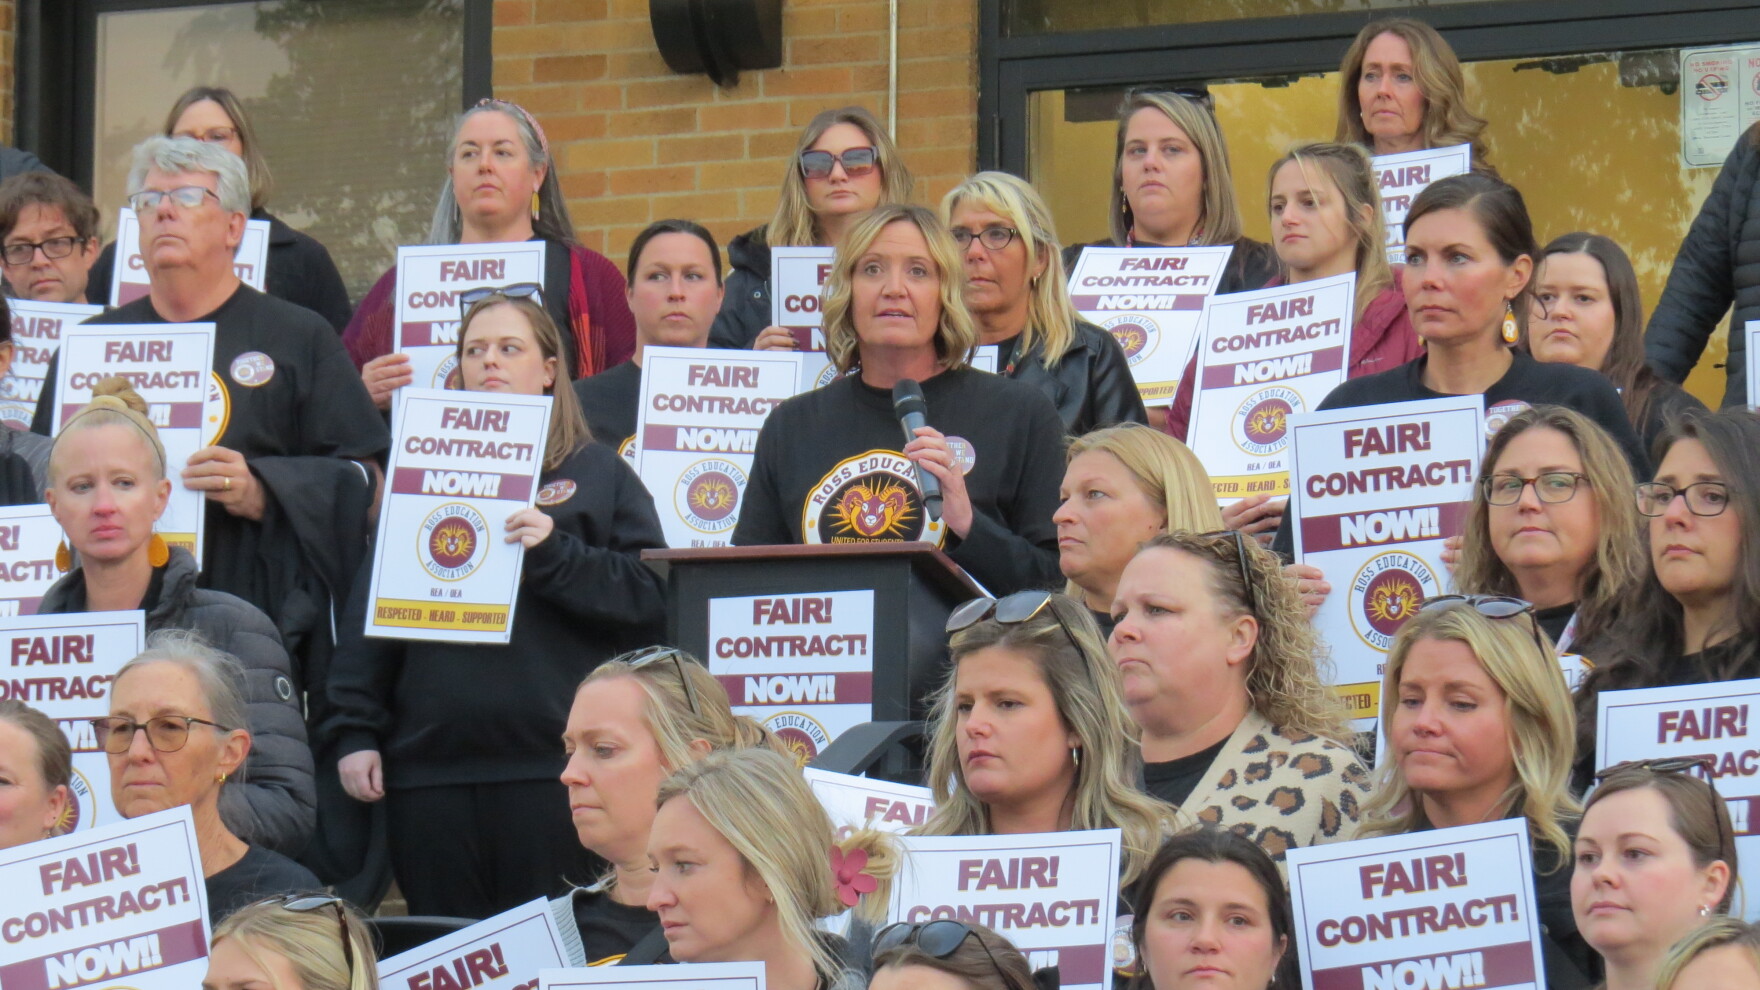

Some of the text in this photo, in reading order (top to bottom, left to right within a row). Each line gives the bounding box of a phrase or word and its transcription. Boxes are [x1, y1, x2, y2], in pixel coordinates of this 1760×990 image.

[440, 259, 505, 282] FAIR!
[1119, 257, 1188, 271] FAIR!
[1082, 275, 1210, 287] CONTRACT!
[1096, 295, 1176, 310] NOW!!
[1246, 296, 1314, 325] FAIR!
[12, 316, 62, 340] AIR!
[1117, 316, 1156, 333] EDUCATION
[1212, 318, 1340, 353] CONTRACT!
[104, 341, 173, 363] FAIR!
[688, 365, 760, 388] FAIR!
[1234, 353, 1312, 385] NOW!!
[652, 393, 784, 416] CONTRACT
[1139, 386, 1174, 396] PPORTED
[1259, 389, 1301, 407] EDUCATION
[441, 407, 511, 432] FAIR!
[405, 436, 533, 462] CONTRACT!
[676, 427, 759, 452] NOW!!
[1241, 436, 1287, 453] ASSOCIATIO
[1343, 421, 1431, 458] FAIR!
[422, 470, 501, 497] NOW!!
[681, 461, 746, 486] ROSS EDUCATION
[813, 457, 917, 505] ROSS EDUCA
[1247, 480, 1276, 492] HEARD
[1306, 459, 1472, 498] CONTRACT!
[424, 505, 485, 532] ROSS EDUCATION
[685, 513, 737, 531] ASSOCIATION
[1340, 507, 1440, 546] NOW!!
[426, 560, 474, 579] ASSOCIATION
[1354, 555, 1432, 593] ROSS EDUCATION
[377, 606, 422, 620] RESPECTED
[429, 609, 455, 622] HEARD
[462, 611, 506, 624] SUPPORTED
[753, 598, 833, 625] FAIR!
[10, 634, 94, 666] FAIR!
[716, 634, 867, 659] CONTRACT!
[744, 675, 836, 703] NOW!!
[774, 715, 826, 744] EDUCATION
[1657, 704, 1749, 744] FAIR!
[864, 796, 934, 827] FAI
[39, 843, 141, 896] FAIR!
[957, 856, 1060, 891] FAIR!
[1359, 852, 1468, 900] FAIR!
[2, 876, 190, 944] CONTRACT!
[1316, 893, 1519, 947] CONTRACT!
[44, 933, 163, 989] NOW!!
[1361, 952, 1485, 990] NOW!!
